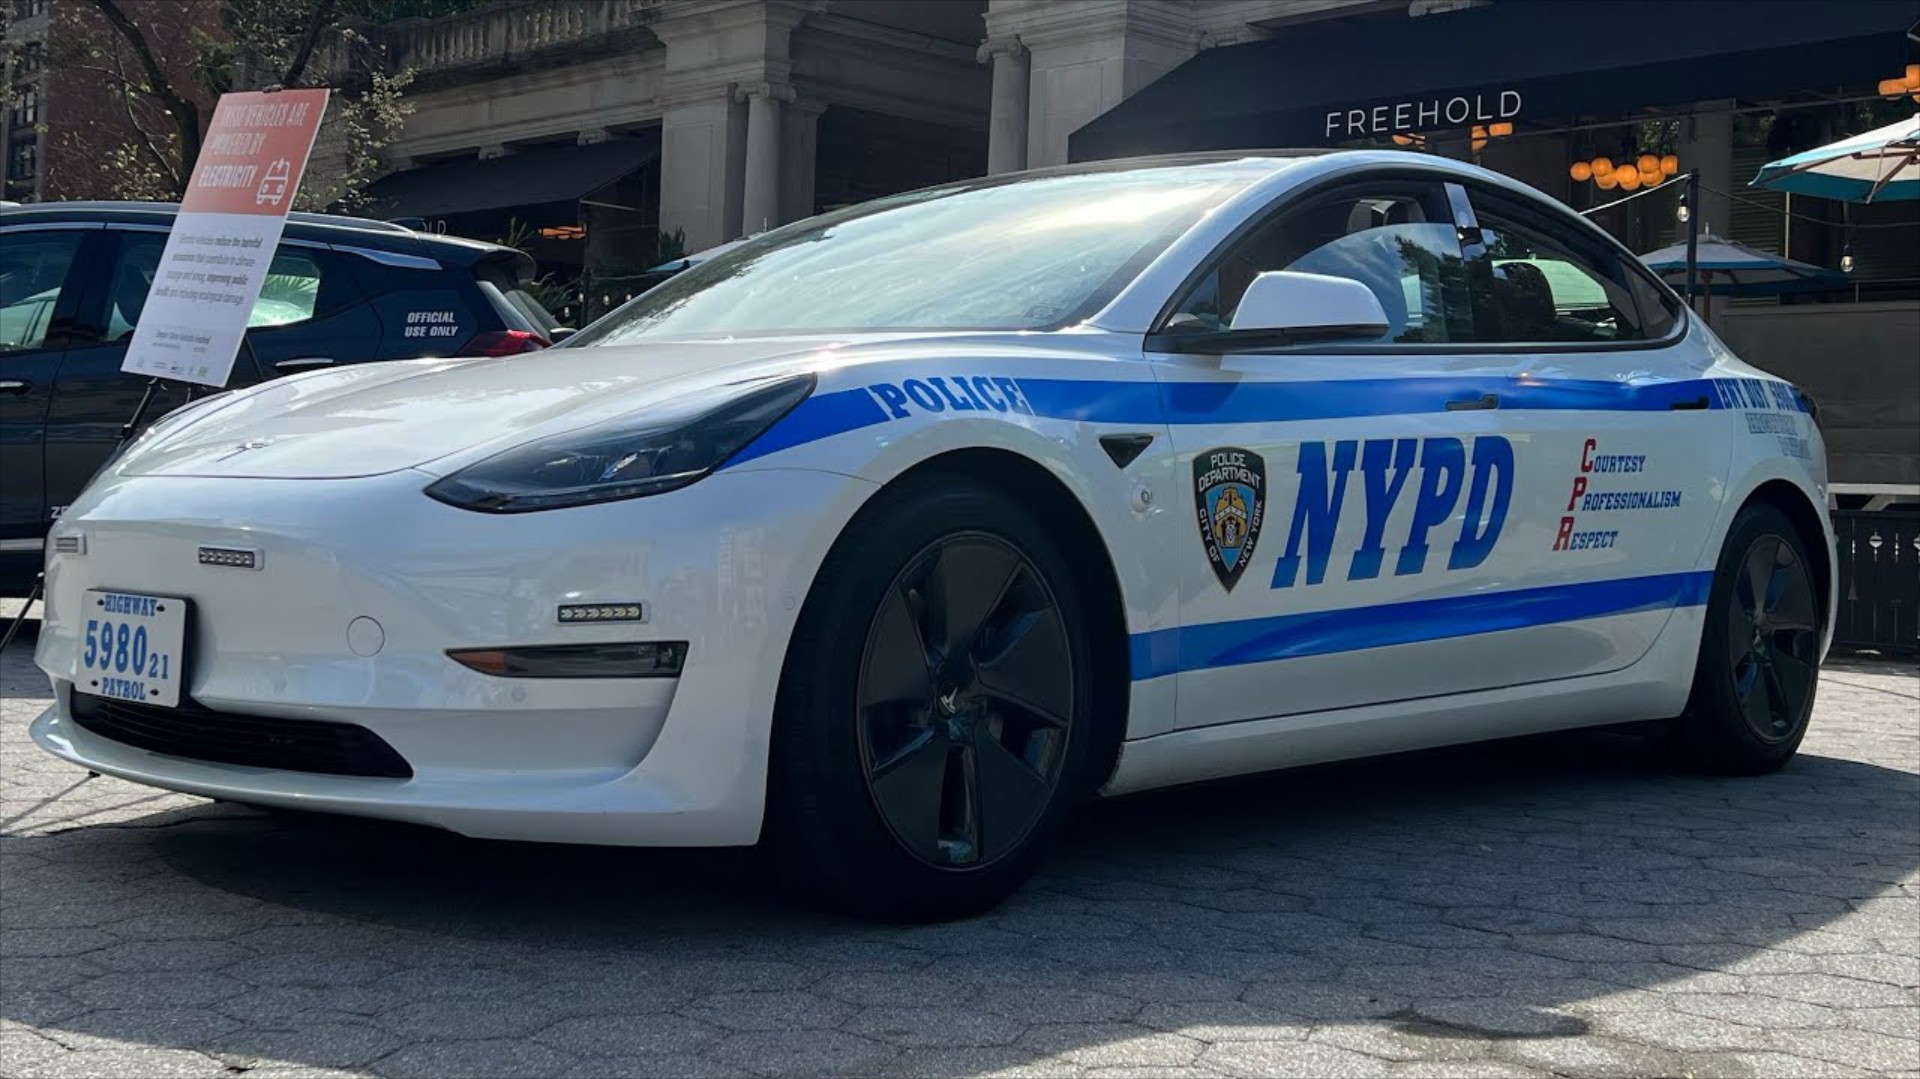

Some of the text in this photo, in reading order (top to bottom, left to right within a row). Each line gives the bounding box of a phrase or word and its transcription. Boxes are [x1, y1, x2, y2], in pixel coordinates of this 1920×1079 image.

[284, 102, 310, 126] ARE
[1326, 90, 1522, 137] FREEHOLD
[197, 164, 258, 188] ELECTRICITY
[404, 326, 458, 337] USE ONLY
[407, 312, 456, 323] OFFICIAL
[868, 376, 1034, 419] POLICE
[1210, 452, 1247, 468] POLICE
[1580, 438, 1646, 473] COURTESY
[1198, 466, 1261, 493] DEPARTMENT
[1567, 476, 1682, 512] PROFESSIONALISM
[1270, 435, 1514, 590] NYPD
[1199, 508, 1221, 564] CITY OF
[1239, 500, 1263, 568] NEW YORK
[1552, 516, 1619, 551] RESPECT
[104, 594, 158, 617] HIGHWAY
[84, 620, 168, 680] 5980 21
[101, 677, 146, 700] PATROL
